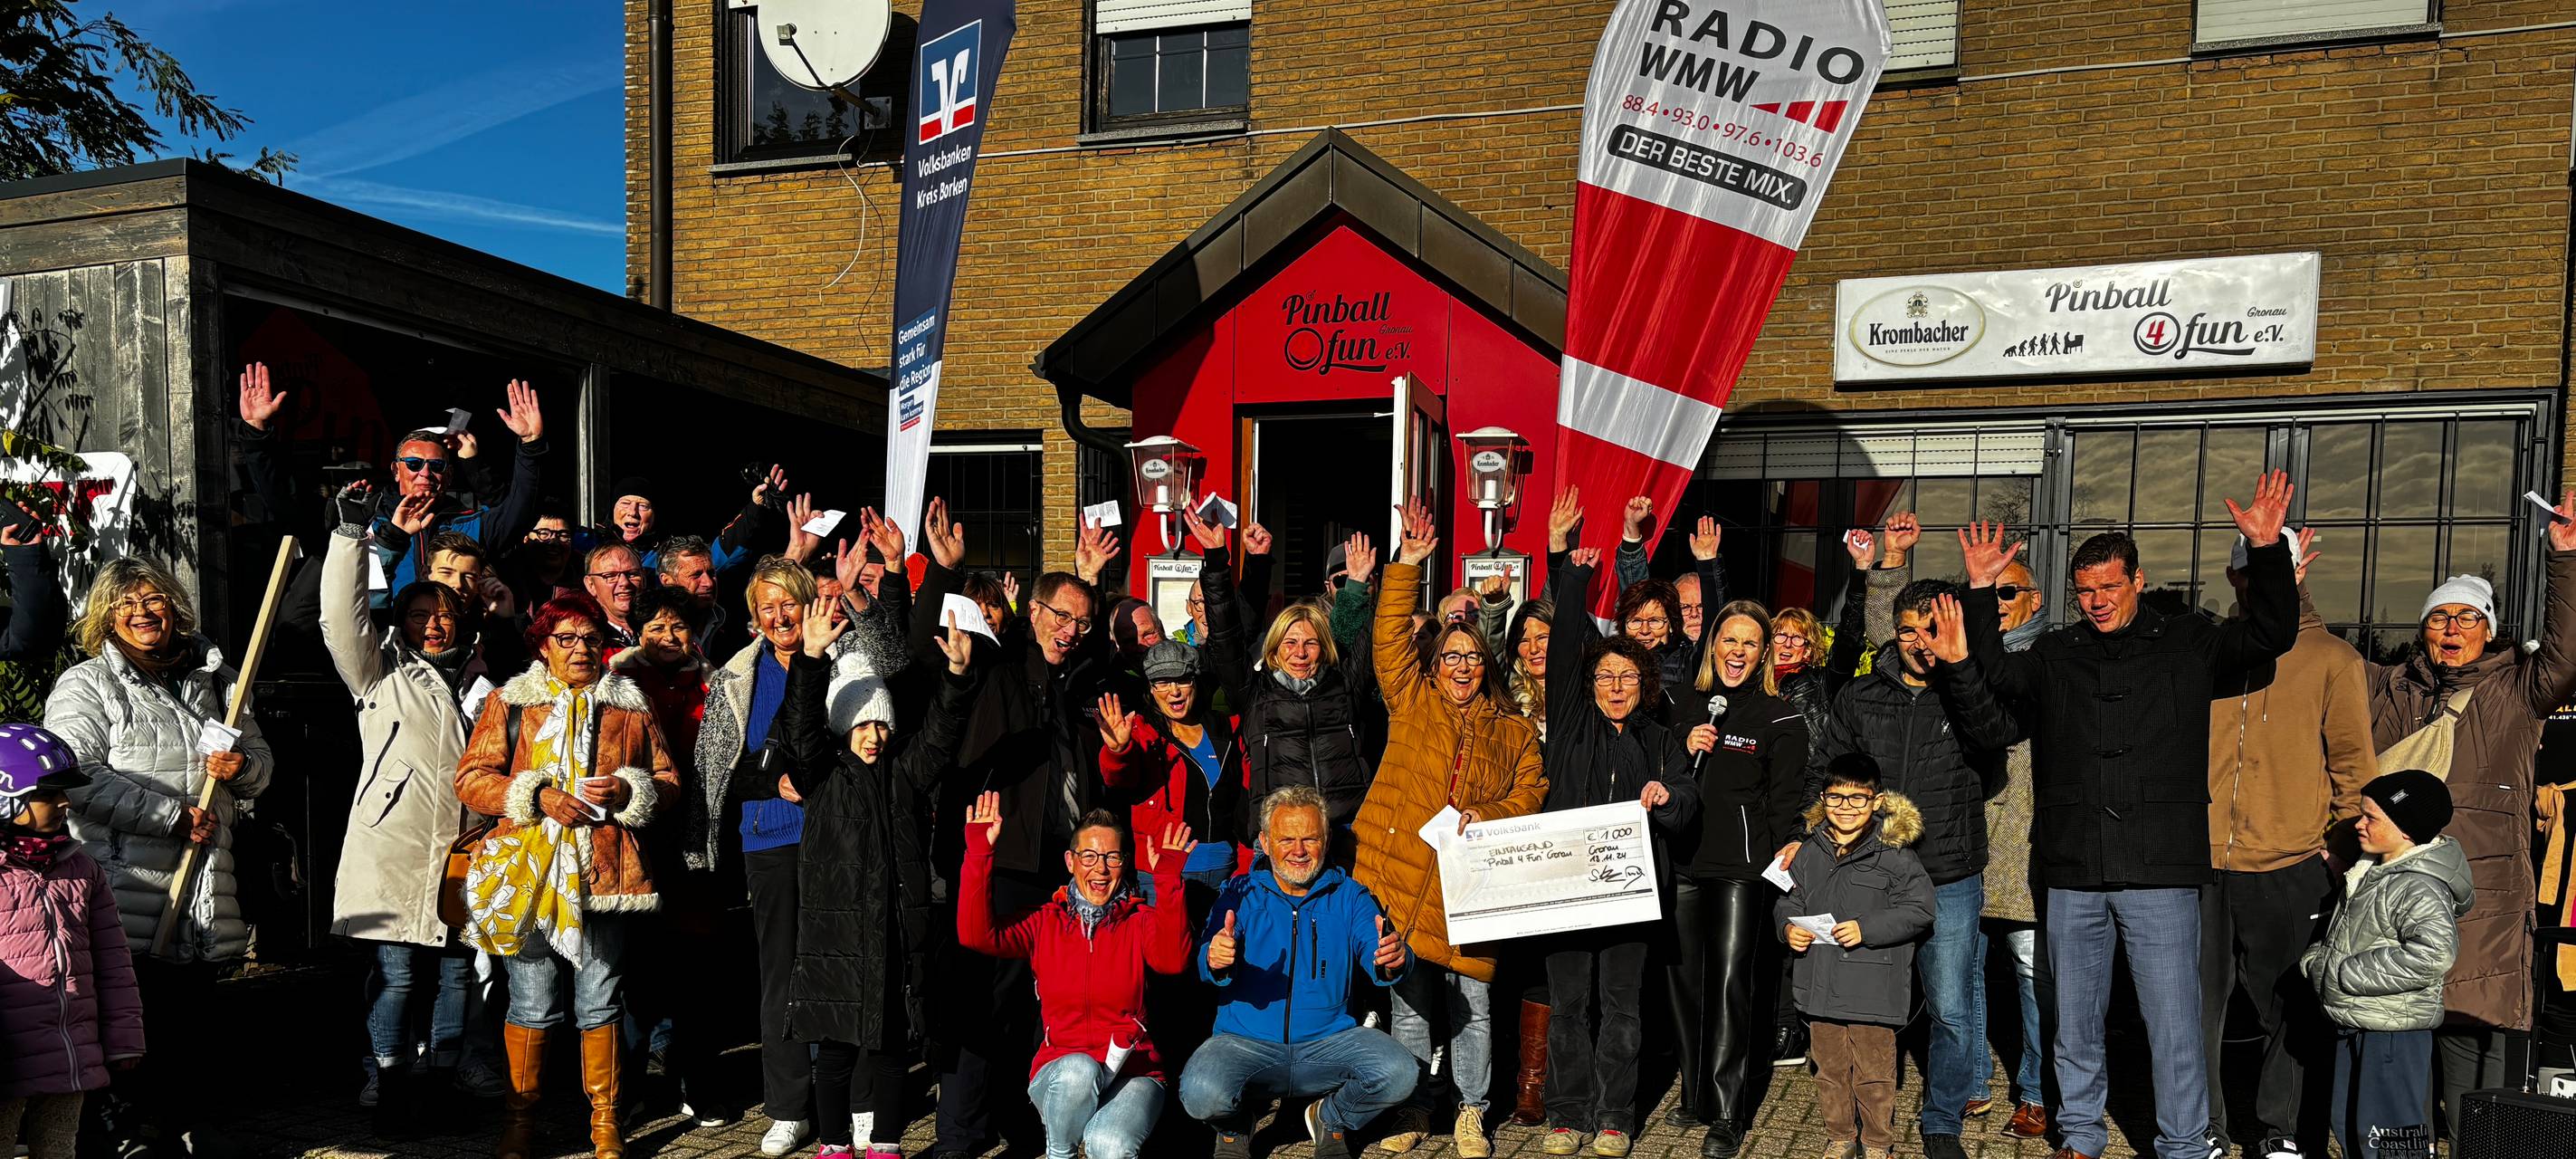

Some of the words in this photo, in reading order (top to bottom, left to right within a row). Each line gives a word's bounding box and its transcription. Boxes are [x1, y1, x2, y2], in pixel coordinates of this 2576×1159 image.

[1649, 0, 1865, 85] RADIO
[1638, 42, 1760, 103] WMW
[1622, 94, 1659, 117] 88.4
[1672, 108, 1710, 131] 93.0
[1722, 123, 1760, 147] 97.6
[1775, 139, 1824, 168] 103.6
[918, 144, 972, 178] Volksbanken
[1618, 131, 1666, 163] DER
[1668, 144, 1743, 186] BESTE
[1743, 170, 1792, 205] MIX.
[917, 184, 939, 209] Kreis
[939, 177, 968, 201] Borken
[1282, 290, 1392, 326] Pinball
[2045, 277, 2172, 312] Pinball
[2247, 306, 2287, 318] Gronau
[898, 314, 935, 345] Gemeinsam
[1868, 320, 1970, 347] Krombacher
[2145, 319, 2166, 347] 4
[2173, 311, 2256, 360] fun
[2254, 323, 2285, 343] e.V.
[899, 347, 916, 369] stark
[916, 341, 926, 360] für
[1319, 329, 1388, 376] fun
[1385, 341, 1412, 359] e.V.
[899, 373, 911, 391] die
[1724, 734, 1757, 745] RADIO
[1724, 740, 1743, 748] WMW
[1485, 822, 1541, 837] Volksbank
[1489, 840, 1554, 857] EINTAUSEND
[1517, 855, 1523, 863] 4
